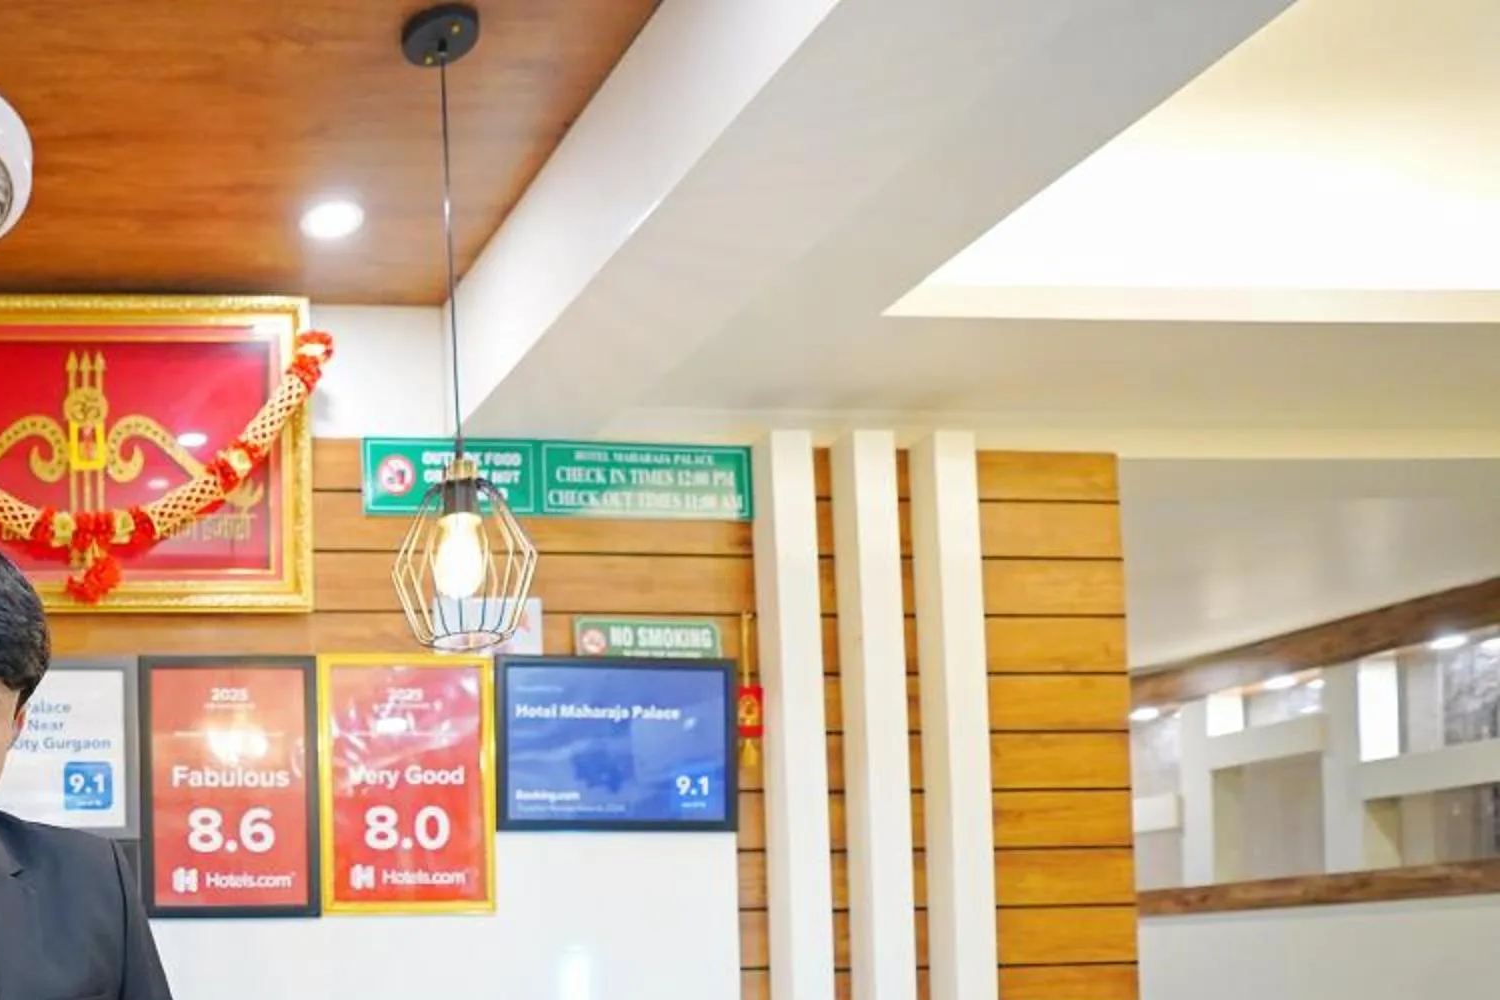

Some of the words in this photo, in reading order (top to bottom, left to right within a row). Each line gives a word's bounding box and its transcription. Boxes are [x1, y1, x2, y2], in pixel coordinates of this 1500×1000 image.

[484, 452, 522, 466] FOOD
[574, 450, 610, 462] HOTEL
[613, 452, 671, 464] MAHARAJA
[674, 453, 715, 465] PALACE
[555, 466, 607, 484] CHECK
[609, 467, 626, 485] IN
[630, 468, 674, 486] TIMES
[712, 471, 736, 488] PM
[548, 489, 601, 507] CHECK
[602, 491, 636, 508] OUT
[638, 492, 681, 509] TIMES
[609, 625, 634, 647] NO
[637, 626, 713, 648] SMOKING
[28, 697, 72, 714] alace
[514, 703, 557, 719] Hotel
[560, 704, 630, 723] Maharaja
[632, 704, 682, 720] Palace
[28, 719, 65, 731] Near
[43, 737, 112, 753] Gurgaon
[68, 773, 105, 794] 9.1
[172, 765, 291, 788] Fabulous
[348, 765, 400, 790] Very
[404, 764, 465, 785] Good
[675, 775, 709, 796] 9.1
[187, 806, 276, 853] 8.6
[364, 805, 451, 851] 8.0
[205, 872, 293, 889] Hotels.com
[381, 870, 467, 887] Hotels.com
